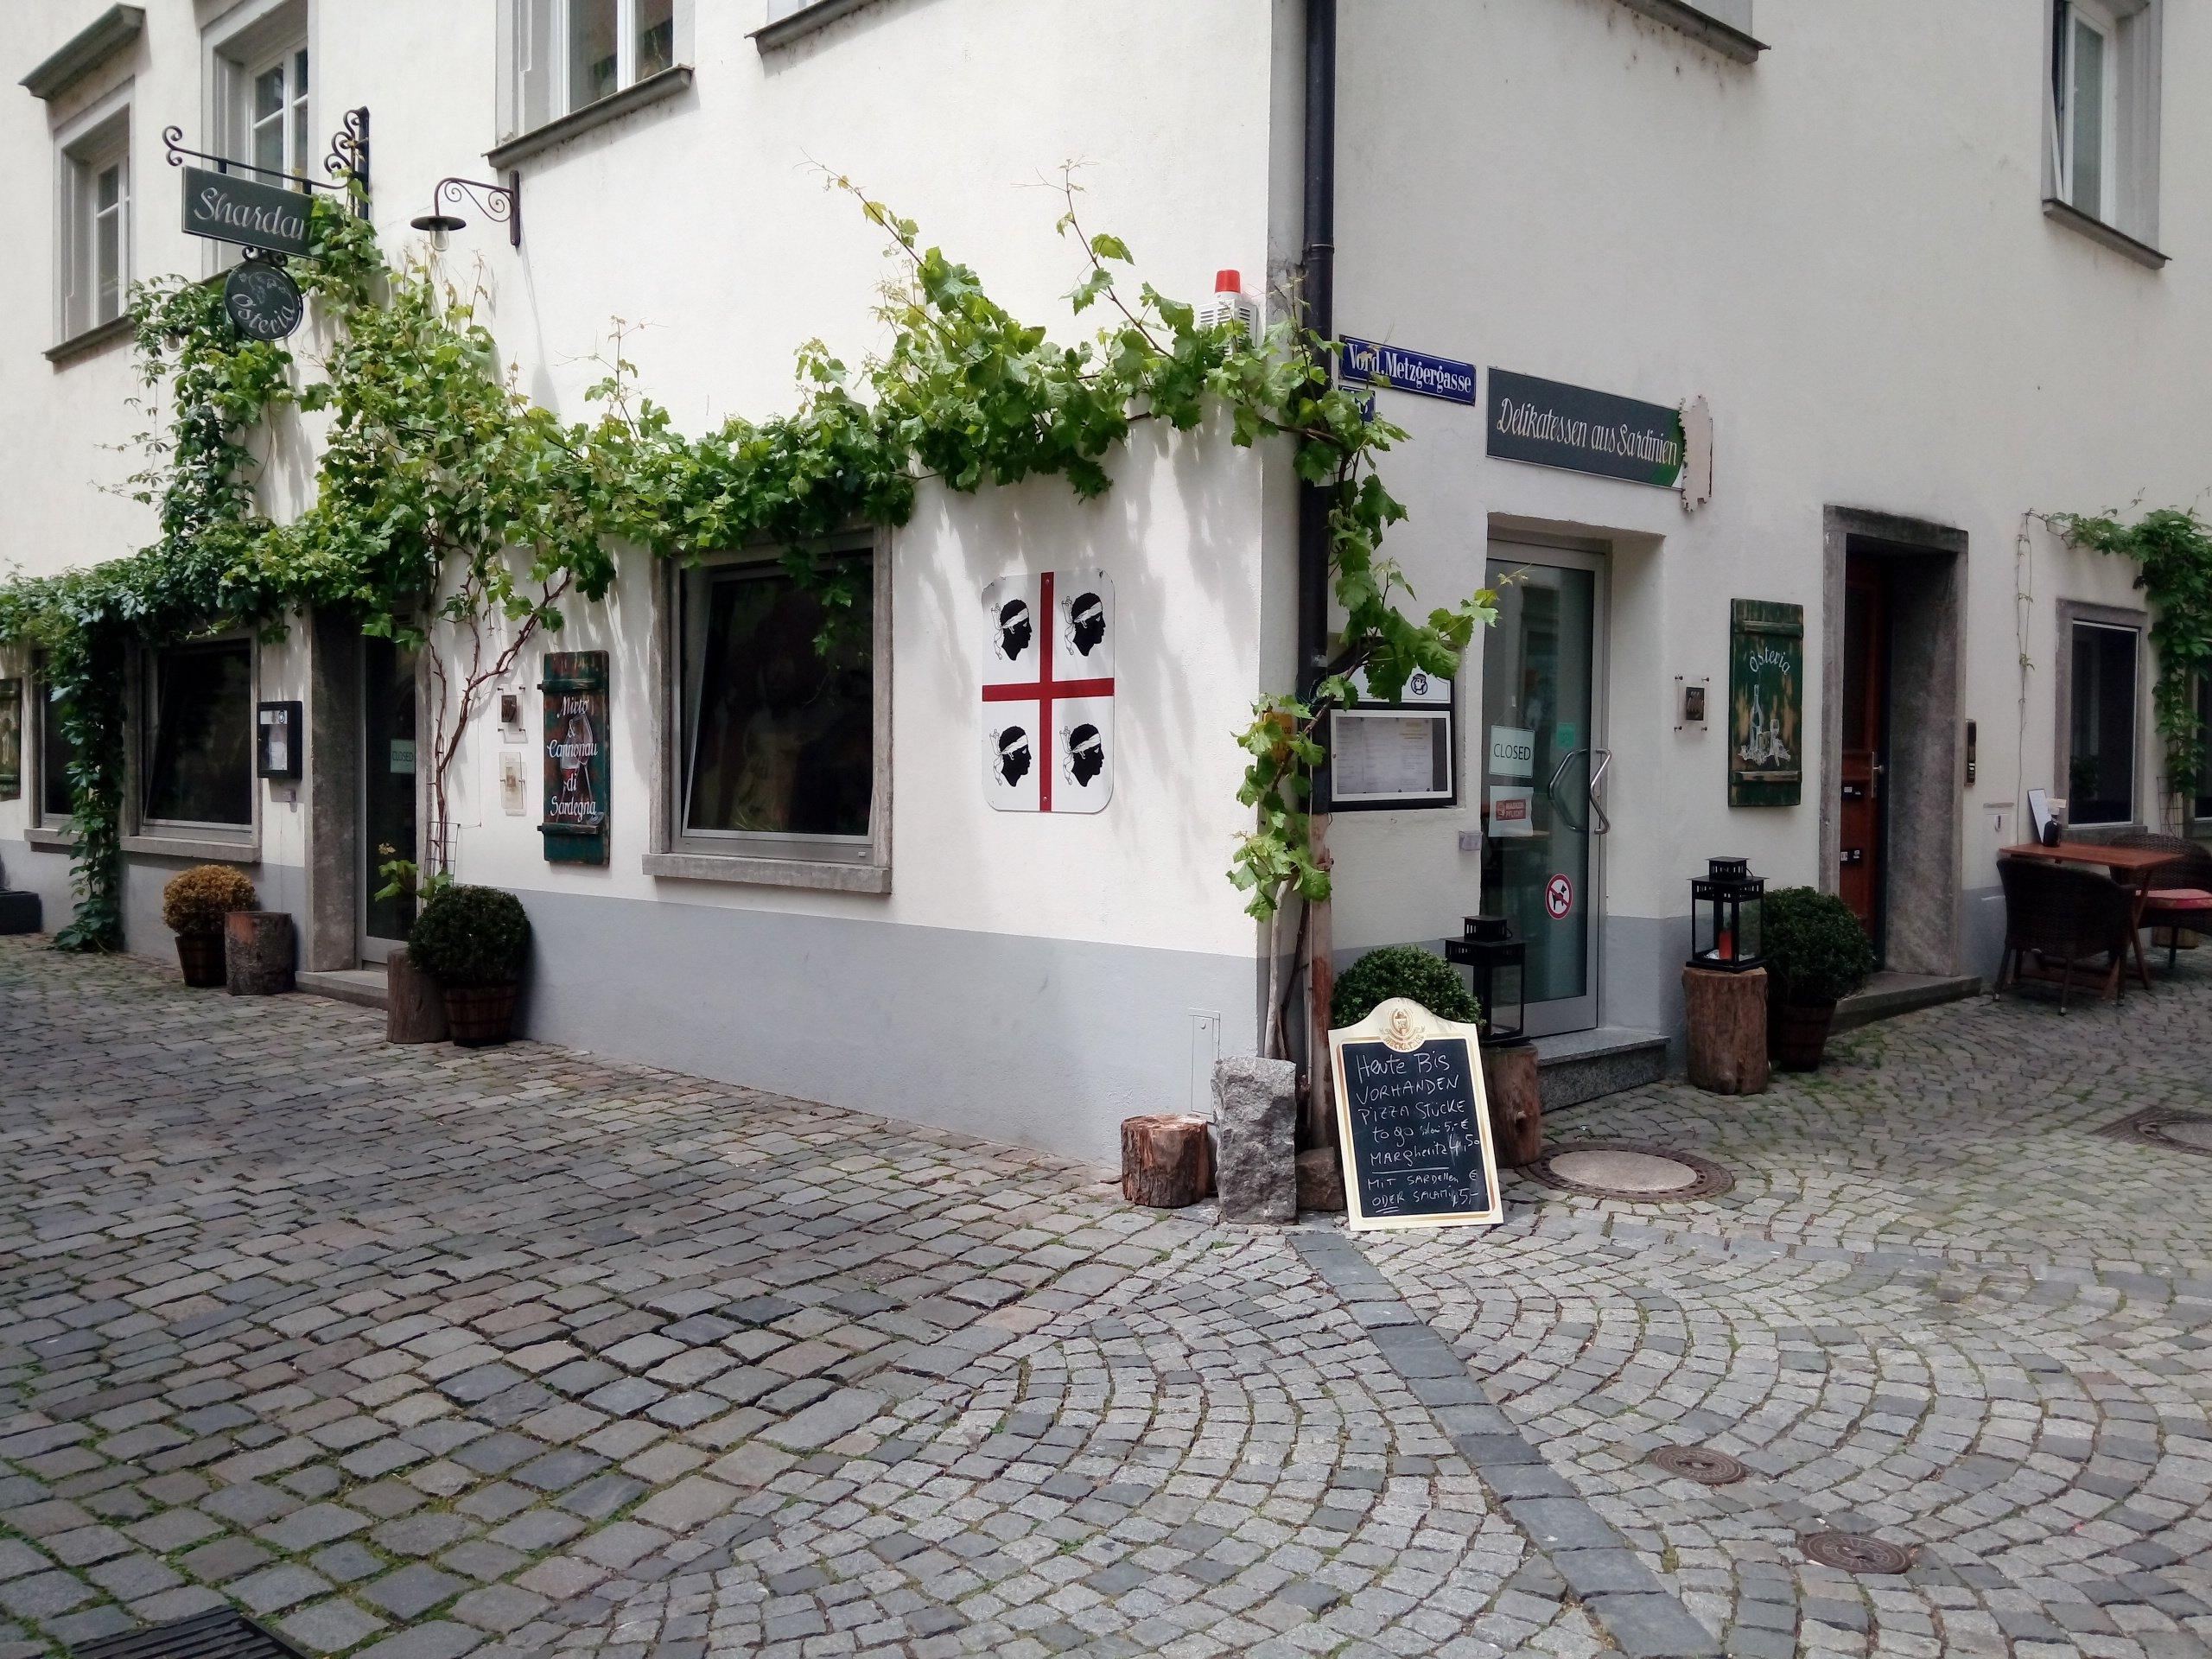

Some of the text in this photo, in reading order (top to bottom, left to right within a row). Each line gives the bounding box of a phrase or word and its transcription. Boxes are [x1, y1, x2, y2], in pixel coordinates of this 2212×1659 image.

[231, 293, 296, 334] Osteria
[1497, 397, 1677, 467] Delikatessen aus Sardinien
[1749, 646, 1791, 676] Osteria
[391, 750, 414, 762] CLOSED
[546, 739, 599, 758] Cannonau
[1493, 743, 1531, 760] CLOSED
[563, 772, 577, 791] di
[550, 795, 597, 823] Sardegna
[1356, 1050, 1450, 1084] Heute Bis
[1356, 1074, 1459, 1105] VORHANDEN
[1372, 1126, 1389, 1143] to
[1394, 1126, 1414, 1147] go
[1372, 1190, 1405, 1207] ODER
